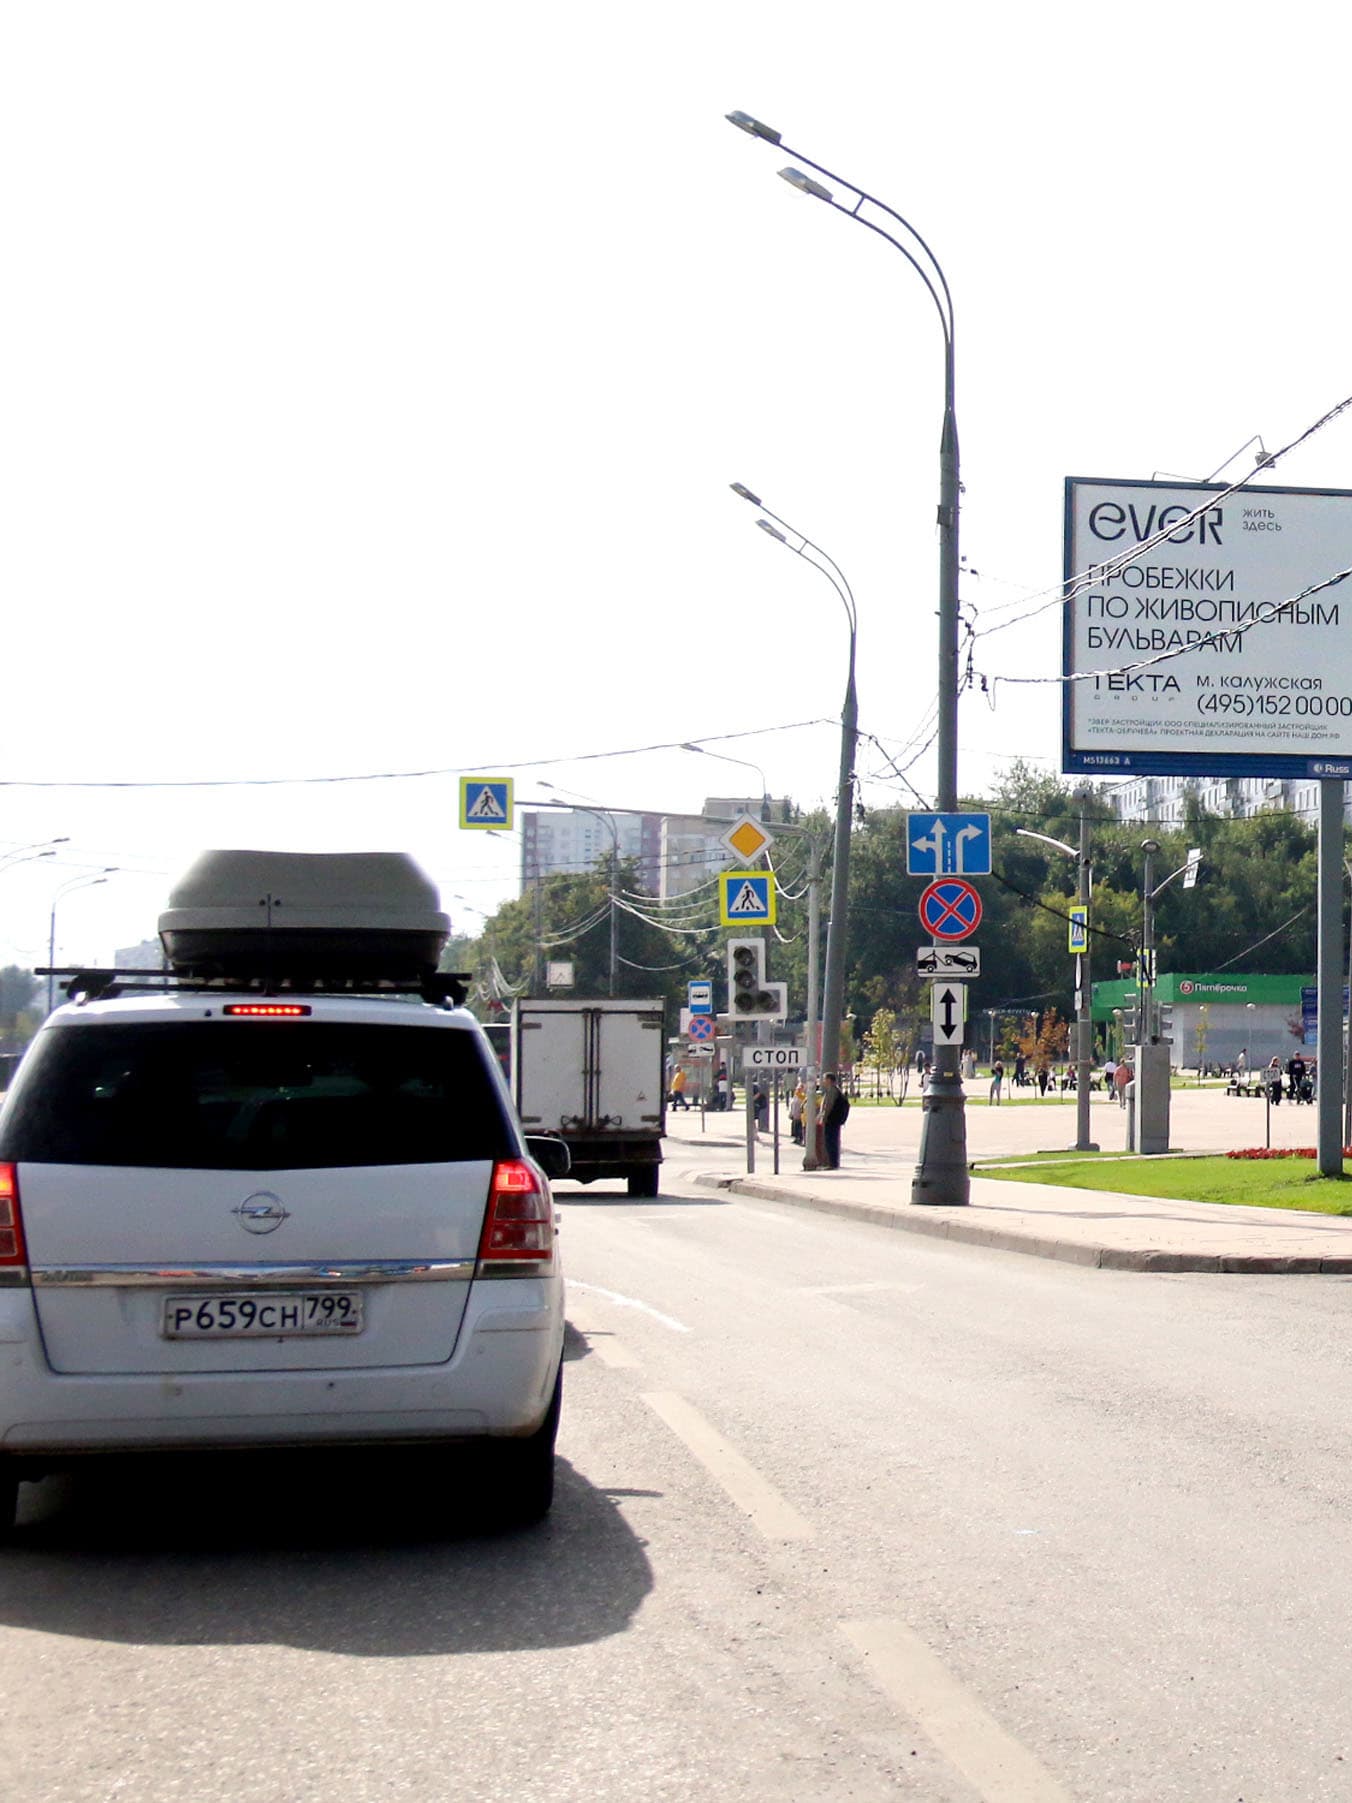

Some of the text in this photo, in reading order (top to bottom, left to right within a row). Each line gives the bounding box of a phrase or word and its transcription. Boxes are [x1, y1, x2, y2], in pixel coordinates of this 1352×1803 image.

[1242, 508, 1275, 519] жить
[1242, 520, 1282, 532] здесь
[1088, 564, 1234, 591] ПРОБЕЖКИ
[1088, 595, 1339, 626] ПО ЖИВОПИСНЫМ
[1088, 627, 1242, 653] БУЛЬВАРАМ
[1220, 676, 1322, 692] калужская
[1324, 763, 1350, 774] Russ
[752, 1050, 799, 1064] СТОП
[306, 1296, 352, 1319] 799
